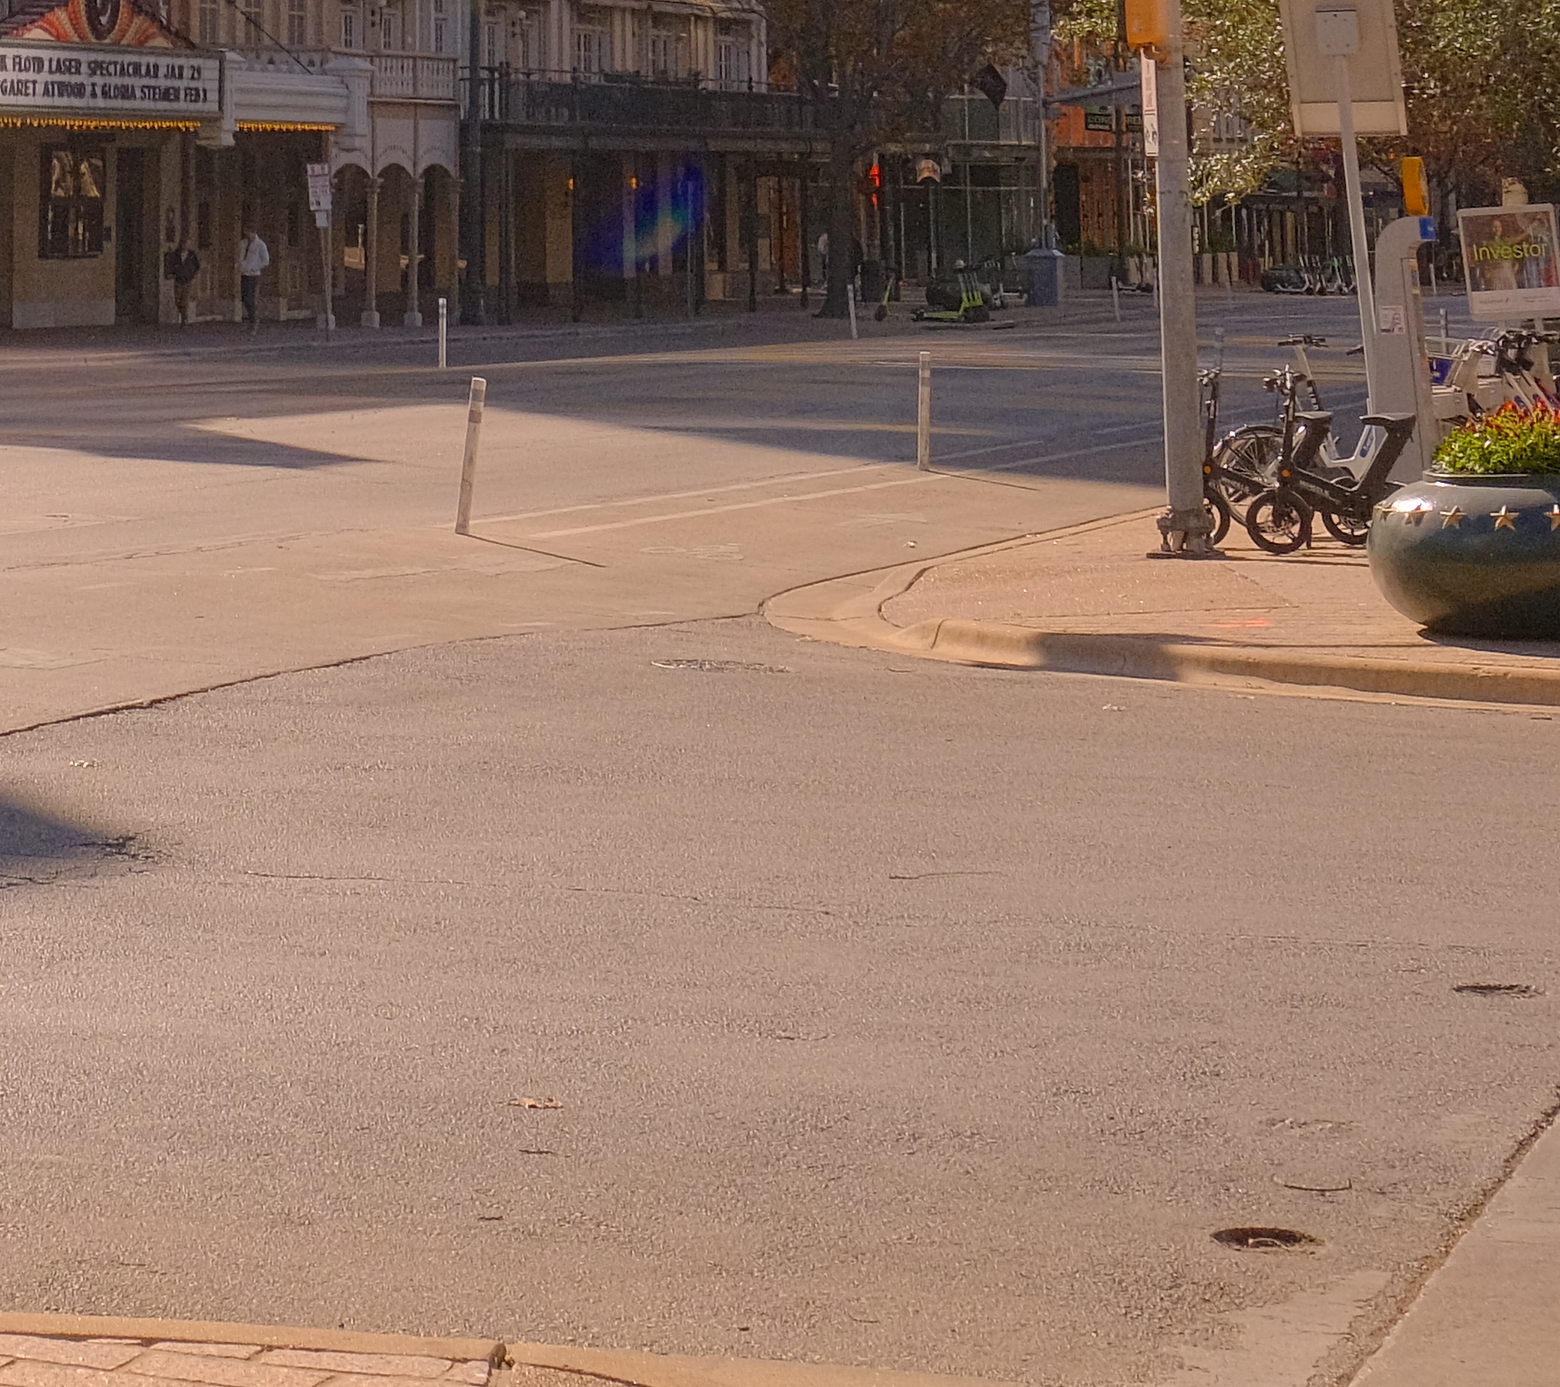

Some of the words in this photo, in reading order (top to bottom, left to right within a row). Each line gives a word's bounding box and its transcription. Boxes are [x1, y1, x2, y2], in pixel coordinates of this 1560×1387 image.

[12, 55, 44, 74] FLOYD
[48, 57, 81, 75] LASER
[87, 59, 160, 79] SPECTACULAR
[164, 64, 184, 80] JAN
[42, 80, 86, 99] ATWOOD
[101, 83, 137, 101] GLORIA
[1473, 242, 1548, 261] Investor
